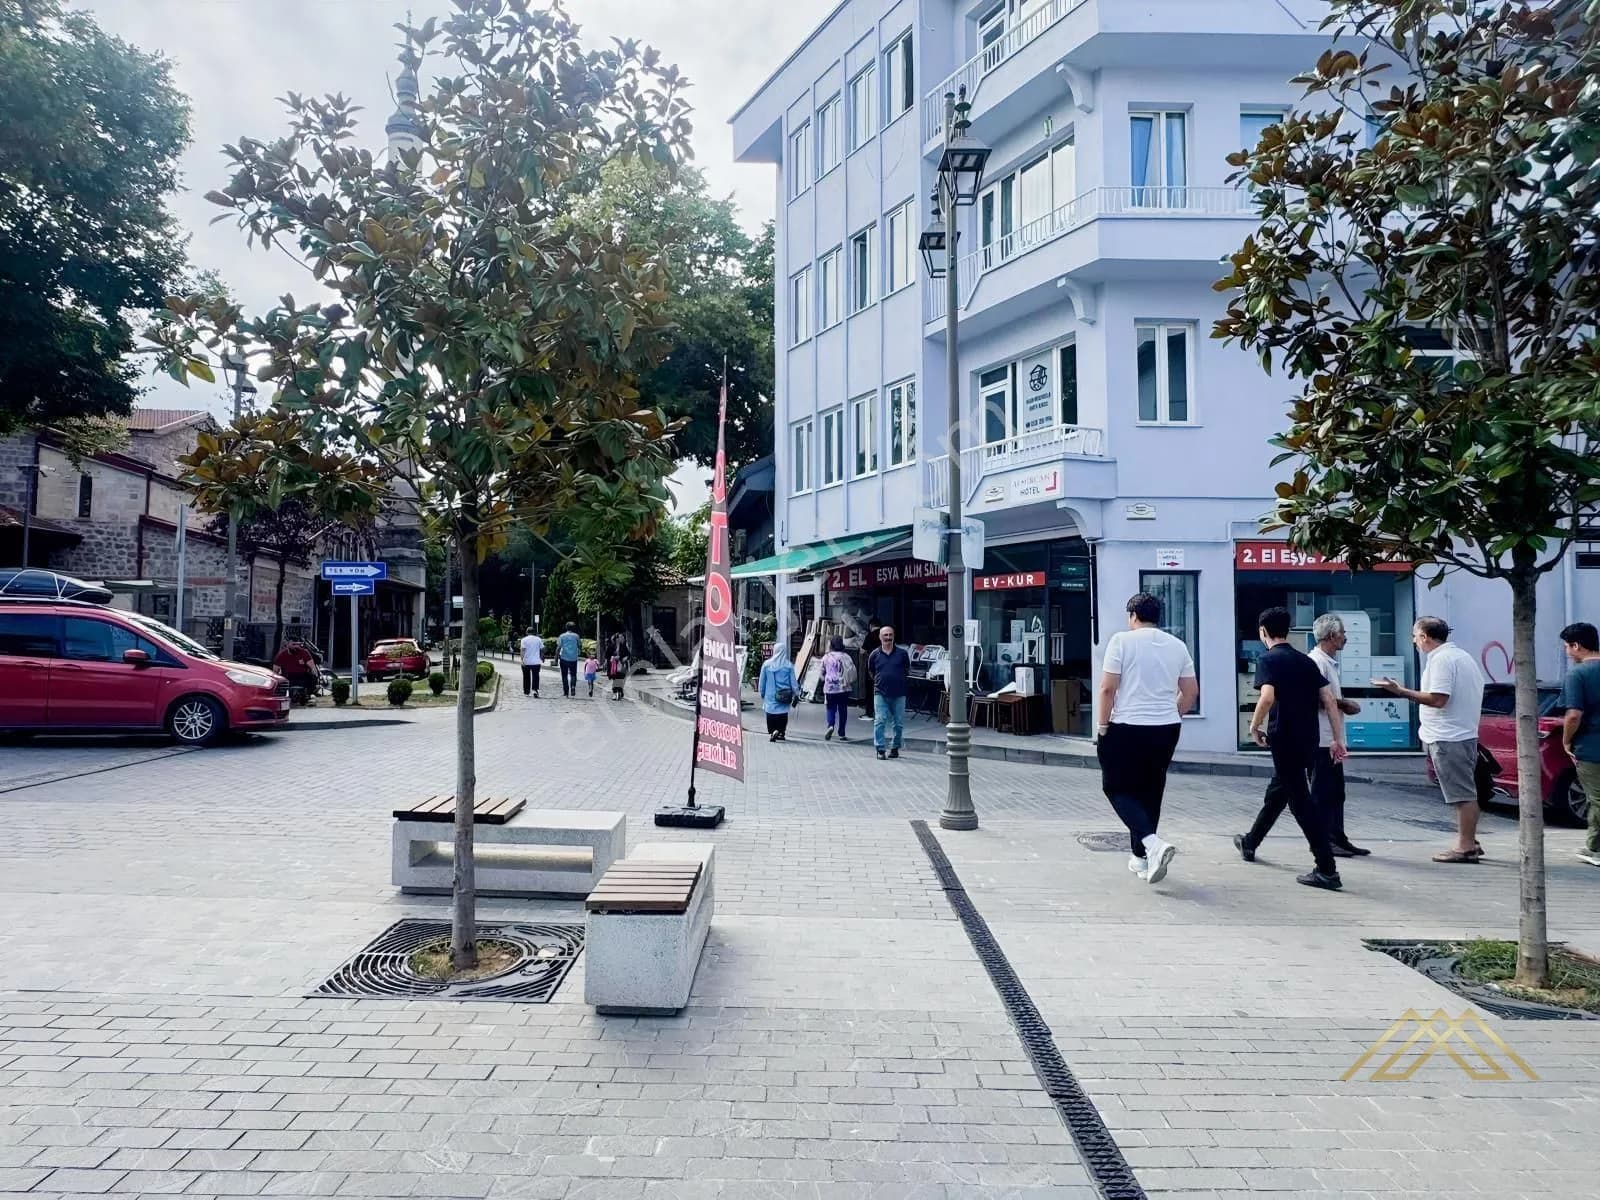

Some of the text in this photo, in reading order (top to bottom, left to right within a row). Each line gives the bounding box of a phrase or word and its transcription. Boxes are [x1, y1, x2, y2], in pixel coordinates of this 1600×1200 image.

[706, 386, 732, 626] OTO
[1243, 549, 1257, 563] 2.
[832, 571, 845, 588] 2.
[849, 569, 867, 587] EL
[876, 567, 900, 583] EŞYA
[983, 574, 1034, 588] EV-KUR
[703, 637, 734, 662] ENKLİ
[700, 689, 738, 717] ERİLİR
[698, 715, 742, 747] OTOKOPİ
